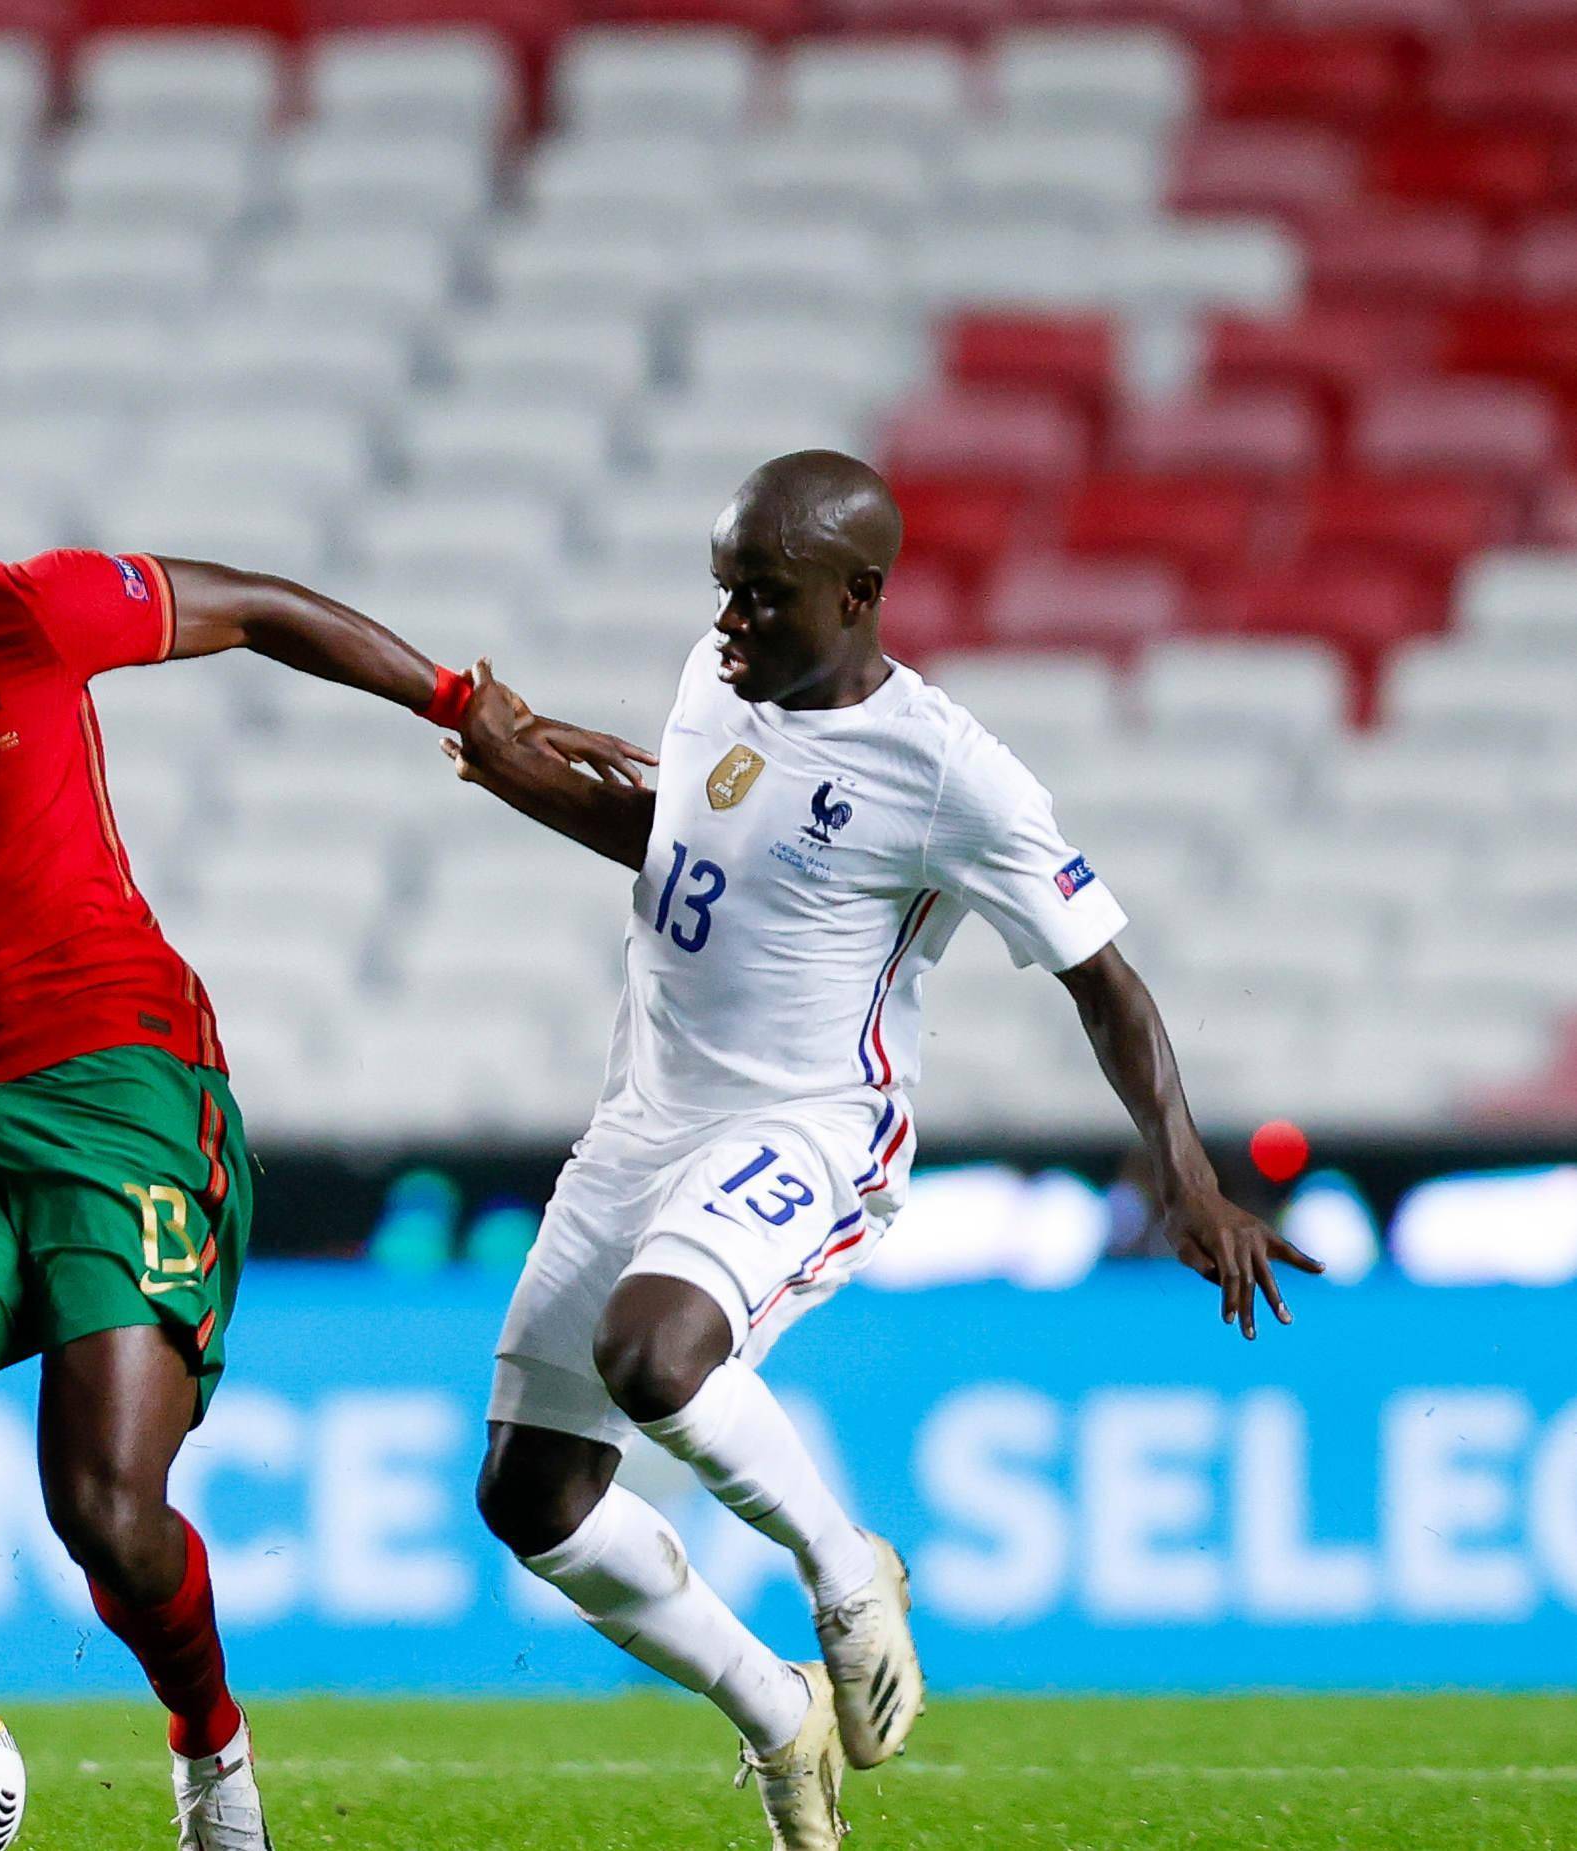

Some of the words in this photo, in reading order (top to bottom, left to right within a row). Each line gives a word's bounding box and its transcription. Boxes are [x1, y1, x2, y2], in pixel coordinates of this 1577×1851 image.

[655, 839, 726, 953] 13
[122, 1183, 198, 1273] 13
[719, 1145, 814, 1226] 13
